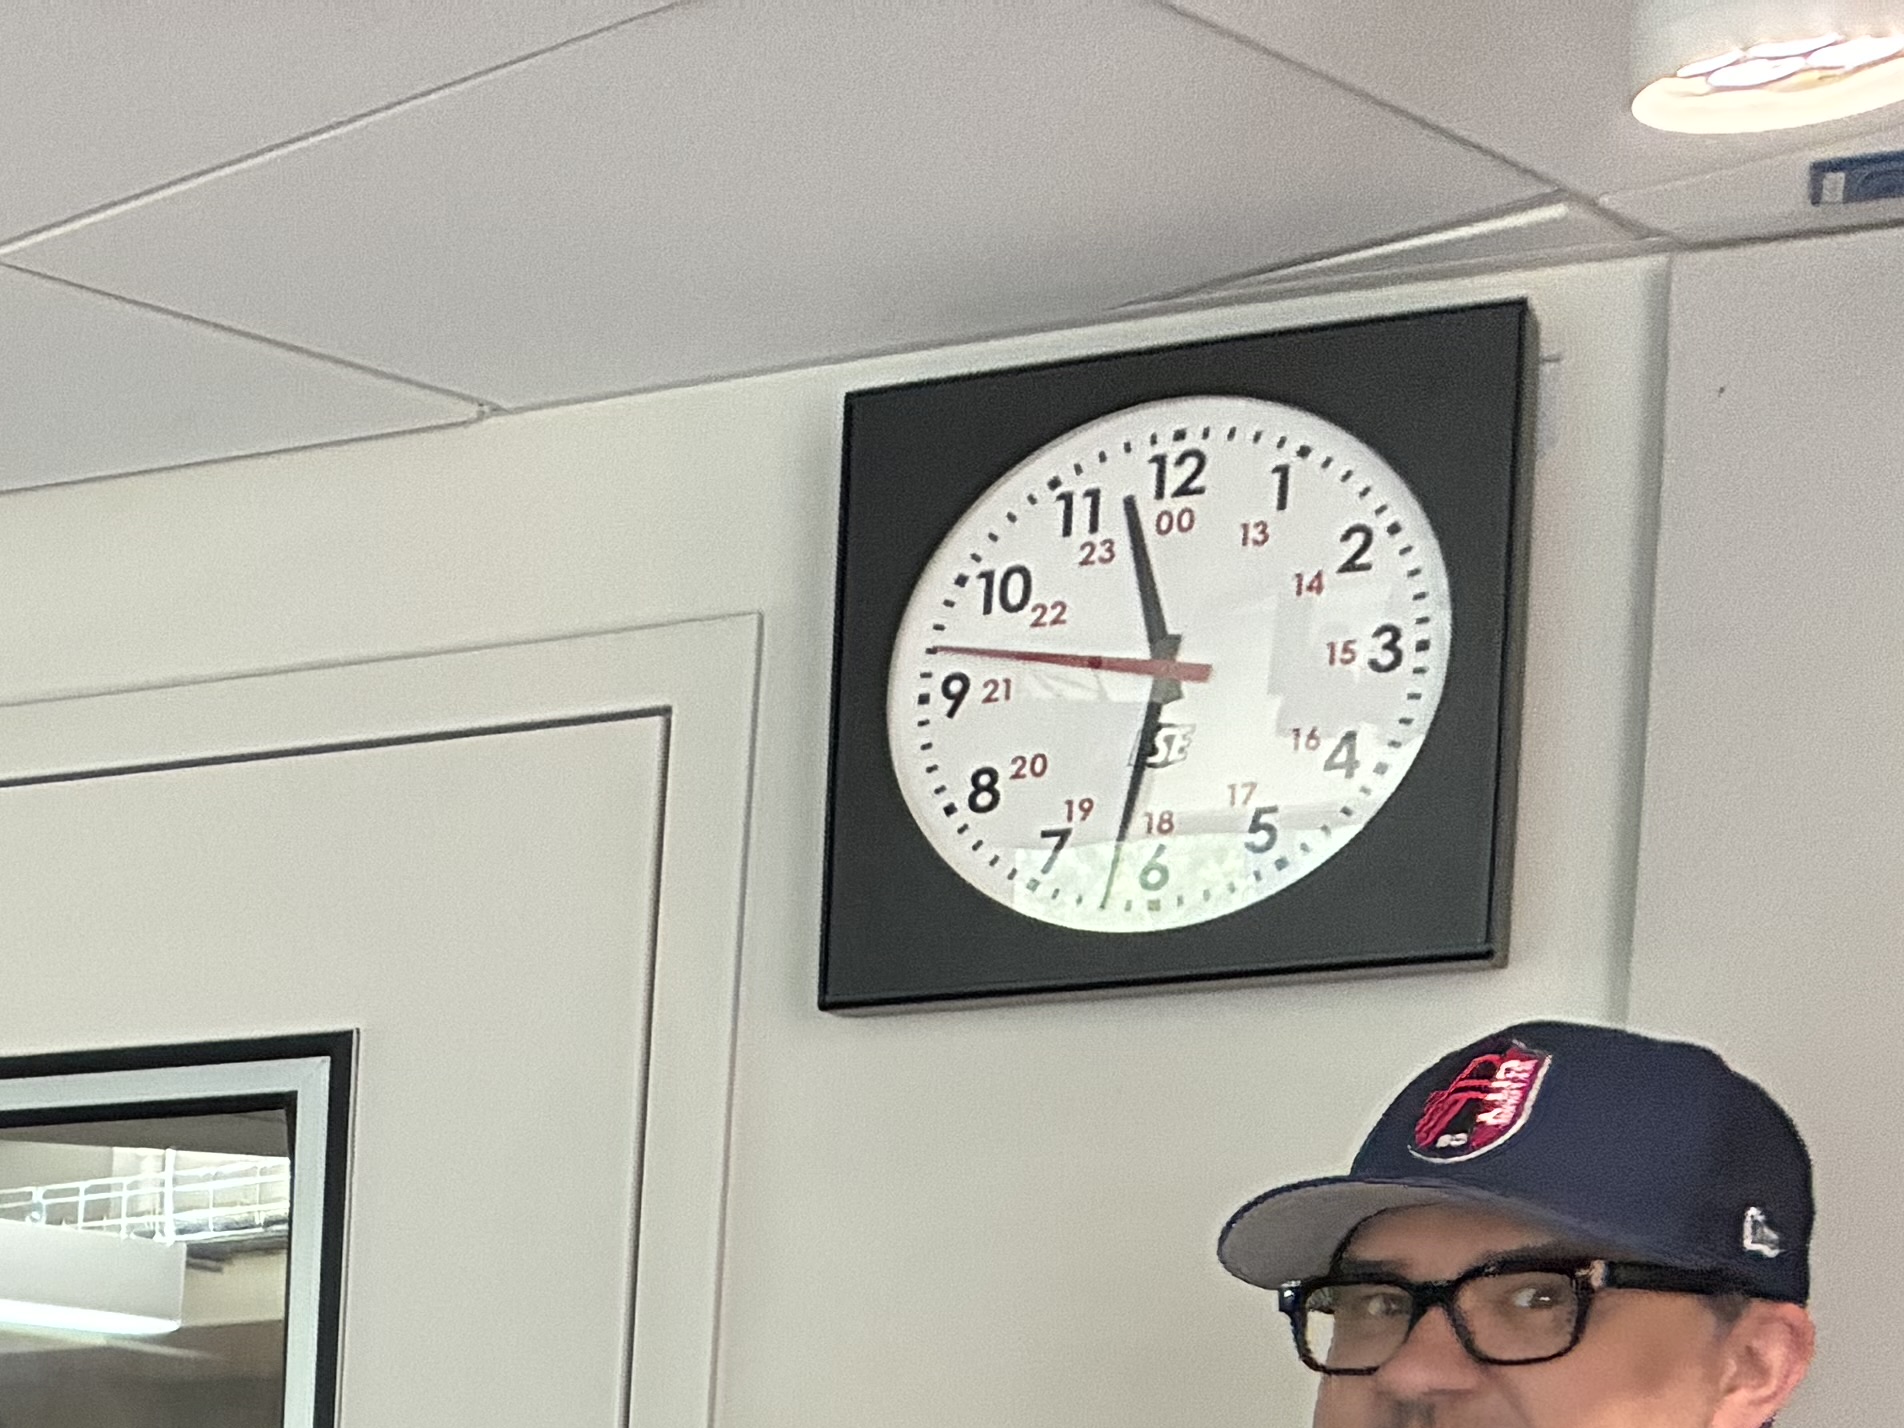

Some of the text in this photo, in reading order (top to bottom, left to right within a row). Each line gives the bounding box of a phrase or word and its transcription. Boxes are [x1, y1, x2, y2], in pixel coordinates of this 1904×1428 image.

[1146, 447, 1207, 500] 12
[1269, 462, 1291, 511] 1
[1054, 487, 1103, 538] 11
[1153, 508, 1196, 536] 00
[1078, 540, 1117, 567] 23
[1239, 521, 1271, 549] 13
[1335, 523, 1374, 574] 2
[975, 563, 1033, 615] 10
[1292, 571, 1325, 596] 14
[1028, 601, 1069, 628] 22
[1325, 640, 1357, 666] 15
[1367, 624, 1404, 674] 3
[939, 672, 972, 719] 9
[981, 678, 1013, 704] 21
[1291, 726, 1321, 752] 16
[1322, 730, 1360, 779] 4
[1008, 753, 1048, 782] 20
[966, 766, 1003, 815] 8
[1226, 782, 1259, 808] 17
[1063, 798, 1095, 824] 19
[1142, 811, 1175, 836] 18
[1243, 805, 1280, 855] 5
[1039, 826, 1073, 875] 7
[1138, 843, 1170, 892] 6
